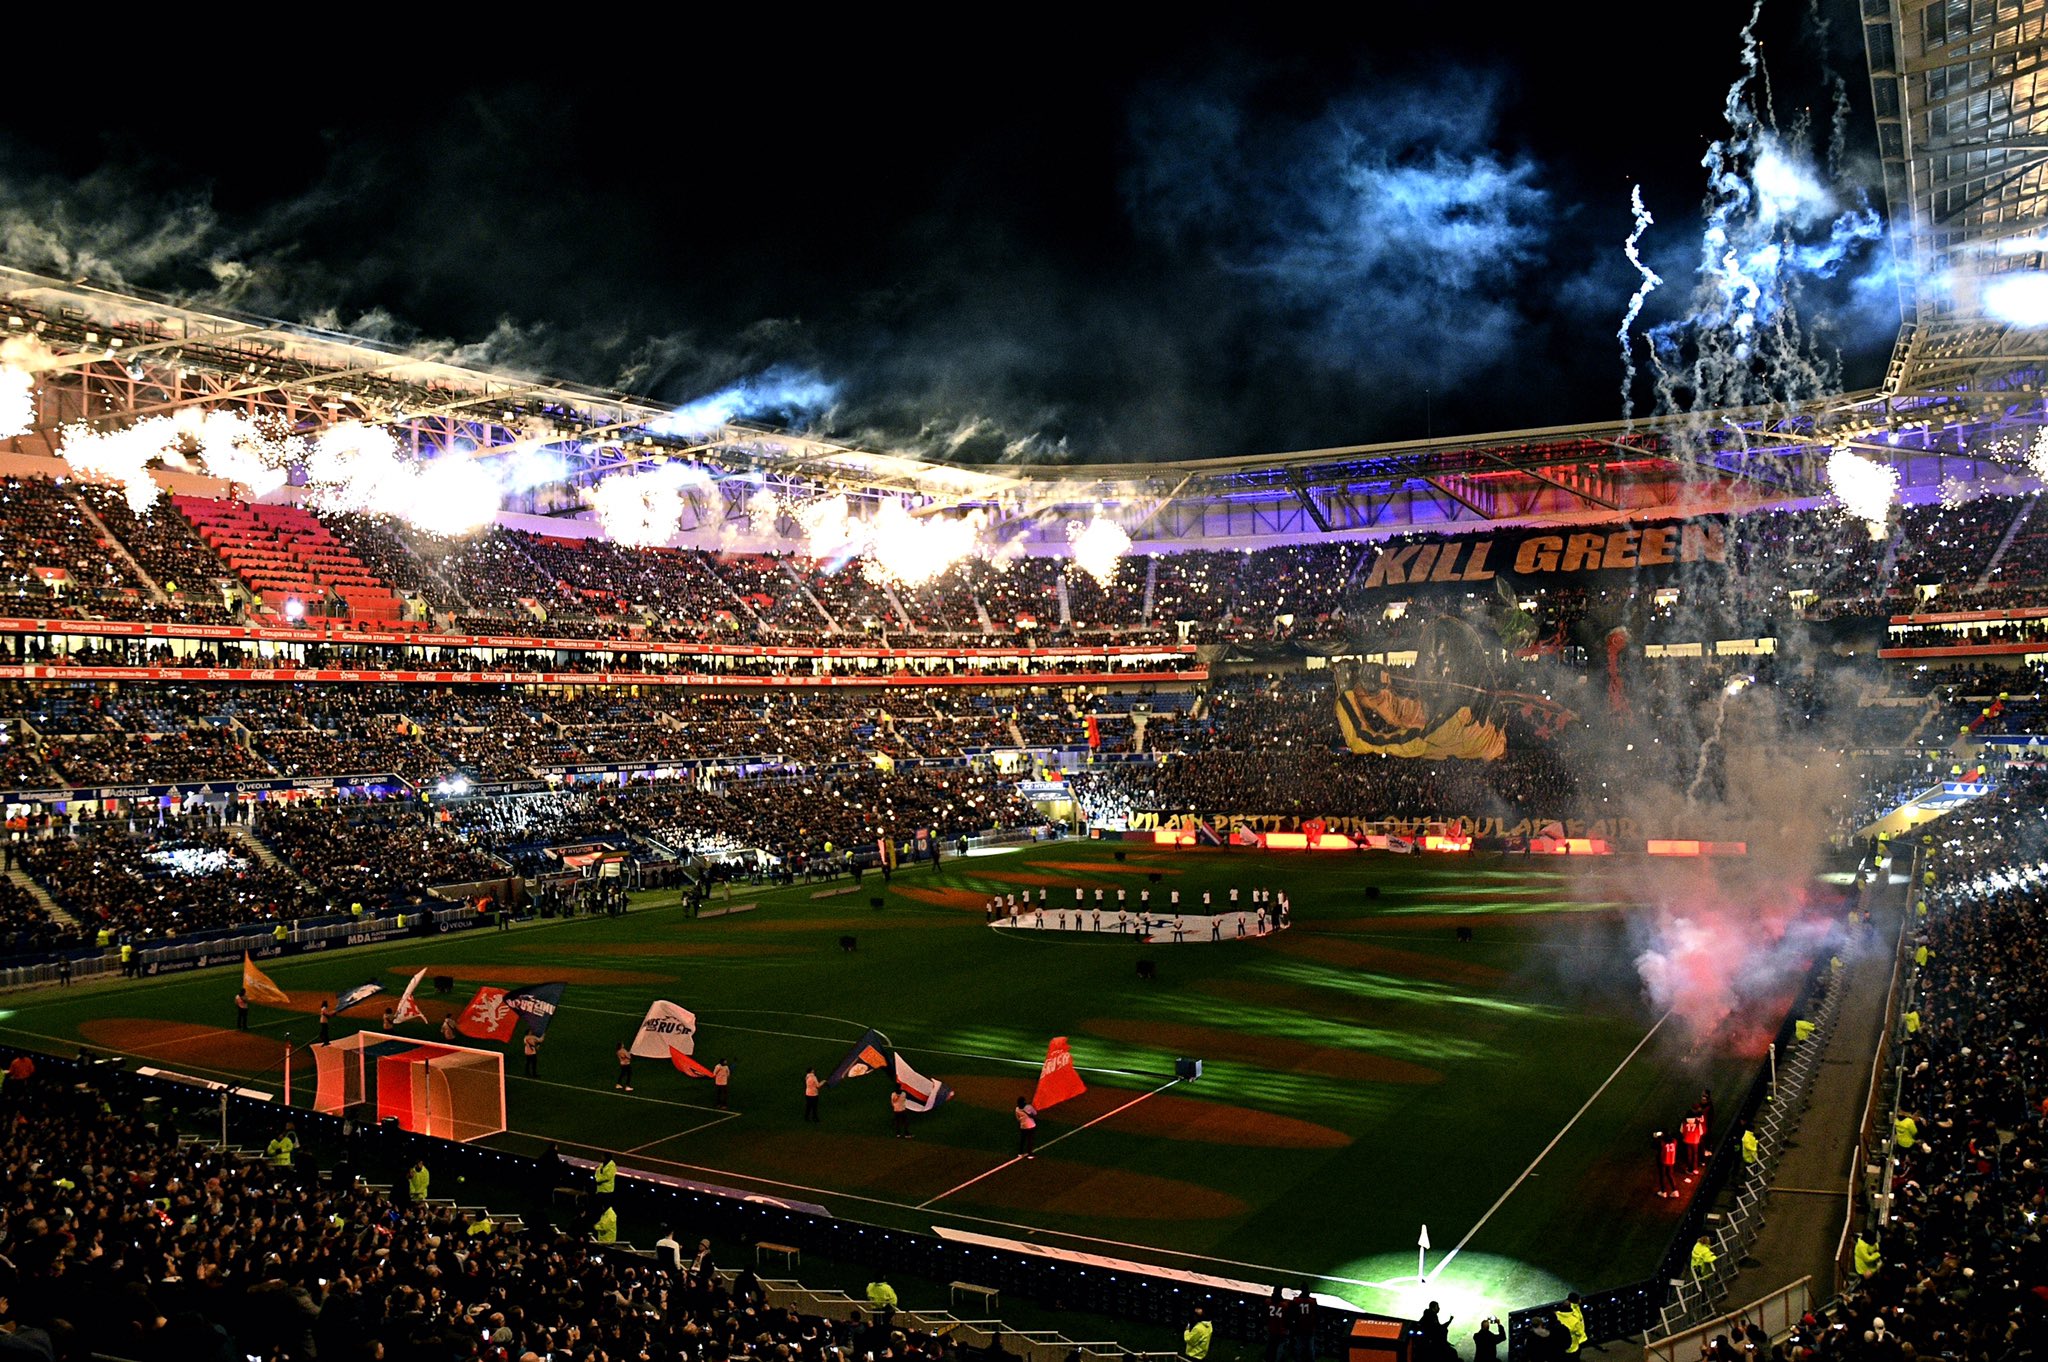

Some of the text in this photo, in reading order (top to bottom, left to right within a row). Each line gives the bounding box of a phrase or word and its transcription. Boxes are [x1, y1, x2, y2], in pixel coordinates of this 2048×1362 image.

[1364, 524, 1725, 588] KILL GREEN
[60, 622, 101, 631] Groupama
[166, 626, 202, 635] Groupama
[260, 630, 292, 638] Groupama
[342, 632, 372, 640] Groupama
[418, 635, 445, 644] Groupama
[488, 637, 513, 645] Groupama
[554, 640, 577, 648] Groupama
[482, 674, 504, 682] Orange
[515, 674, 536, 682] Orange
[360, 776, 388, 784] HYUNDAI
[246, 782, 272, 790] VEOLIA
[109, 788, 149, 798] Adéquat
[348, 933, 371, 945] MDA
[209, 954, 242, 964] deliveroo
[159, 960, 194, 972] deliveroo
[1686, 1124, 1696, 1132] 17
[1665, 1144, 1674, 1152] 13
[1269, 1306, 1282, 1318] 24
[1300, 1303, 1310, 1314] 11
